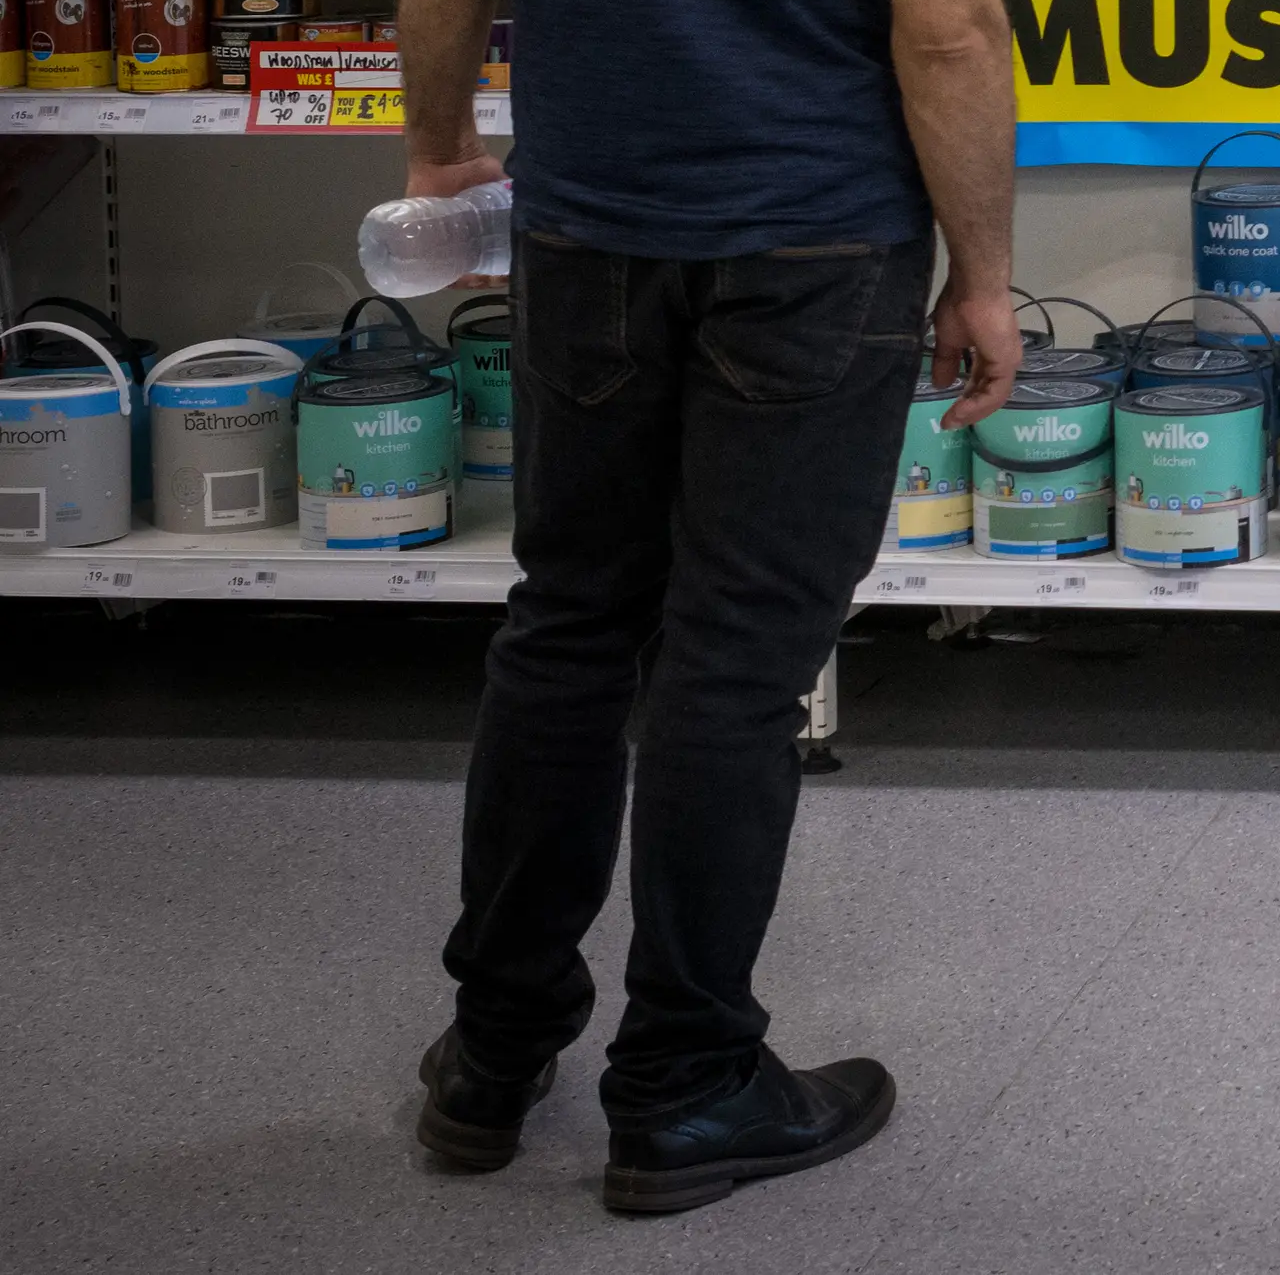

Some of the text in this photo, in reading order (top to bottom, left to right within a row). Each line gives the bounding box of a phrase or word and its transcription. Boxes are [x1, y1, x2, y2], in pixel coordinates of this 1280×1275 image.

[1208, 215, 1269, 240] wilko
[1203, 244, 1278, 257] quick one coat
[185, 408, 279, 432] bathroom
[352, 410, 422, 438] wilko
[365, 441, 410, 454] kitchen
